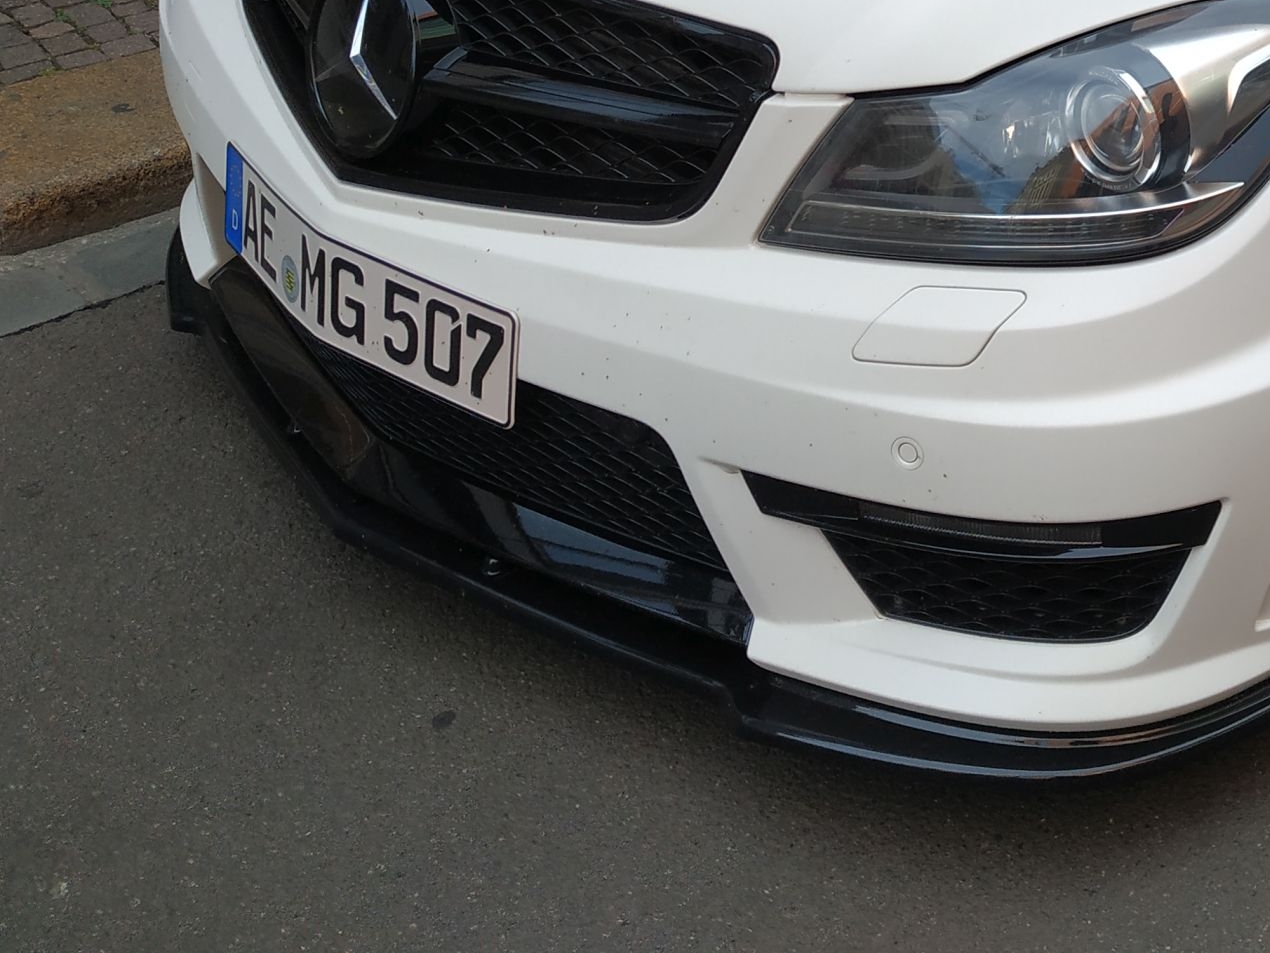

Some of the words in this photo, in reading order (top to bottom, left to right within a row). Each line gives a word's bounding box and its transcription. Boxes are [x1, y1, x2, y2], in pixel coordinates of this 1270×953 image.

[231, 209, 239, 231] D
[244, 179, 277, 284] AE
[301, 233, 365, 346] MG
[384, 278, 505, 399] 507
